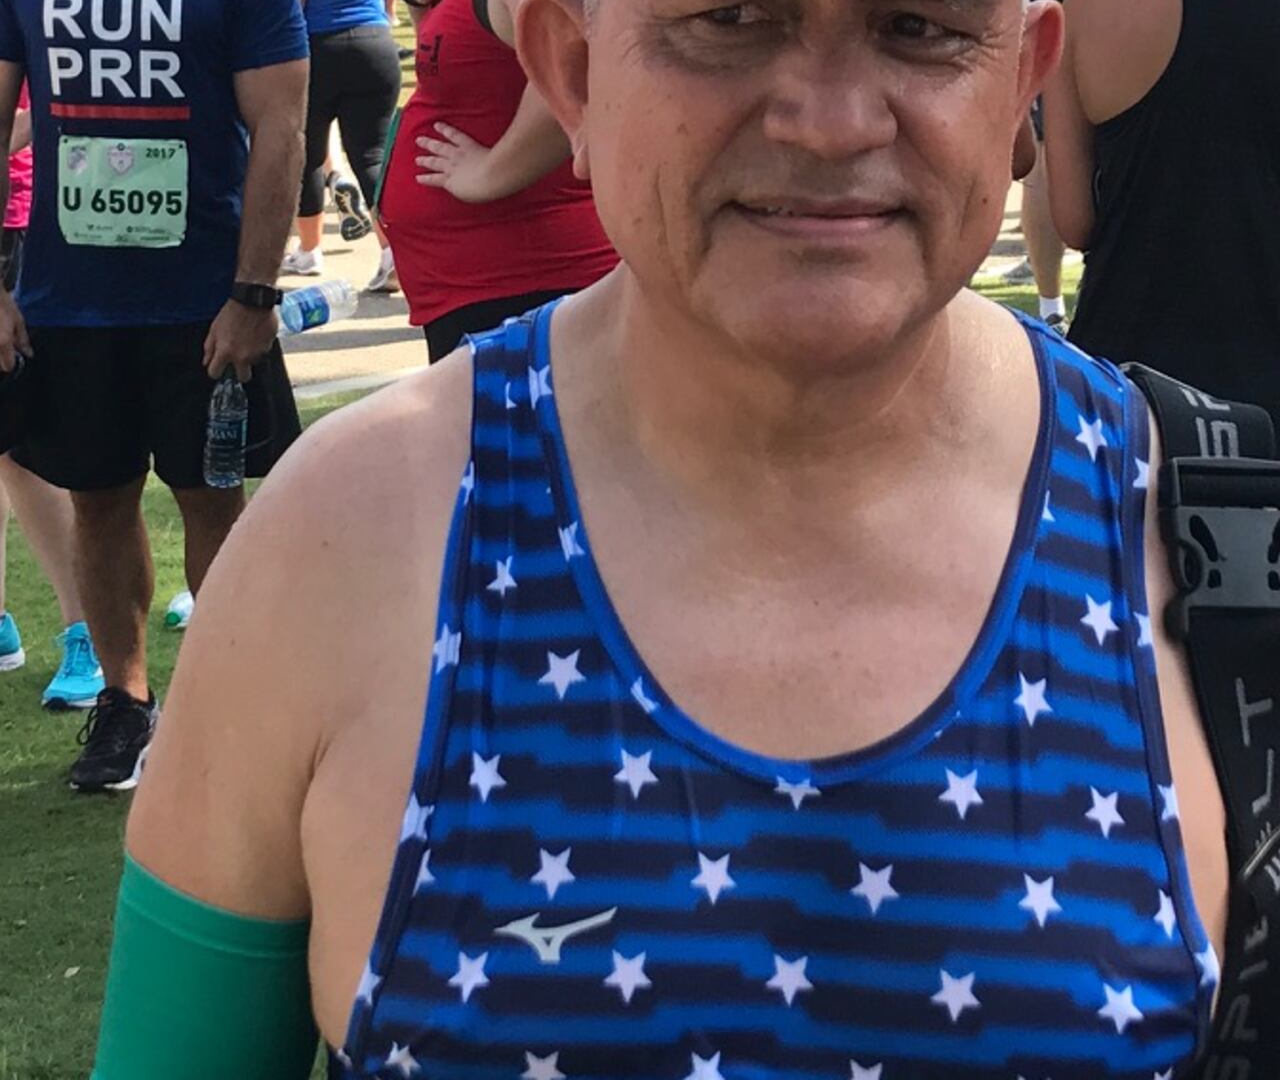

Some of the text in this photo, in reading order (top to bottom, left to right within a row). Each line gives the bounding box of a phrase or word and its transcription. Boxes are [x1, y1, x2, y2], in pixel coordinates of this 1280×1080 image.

[47, 46, 186, 98] PRR
[145, 147, 176, 160] 2017
[63, 185, 183, 216] U 65095
